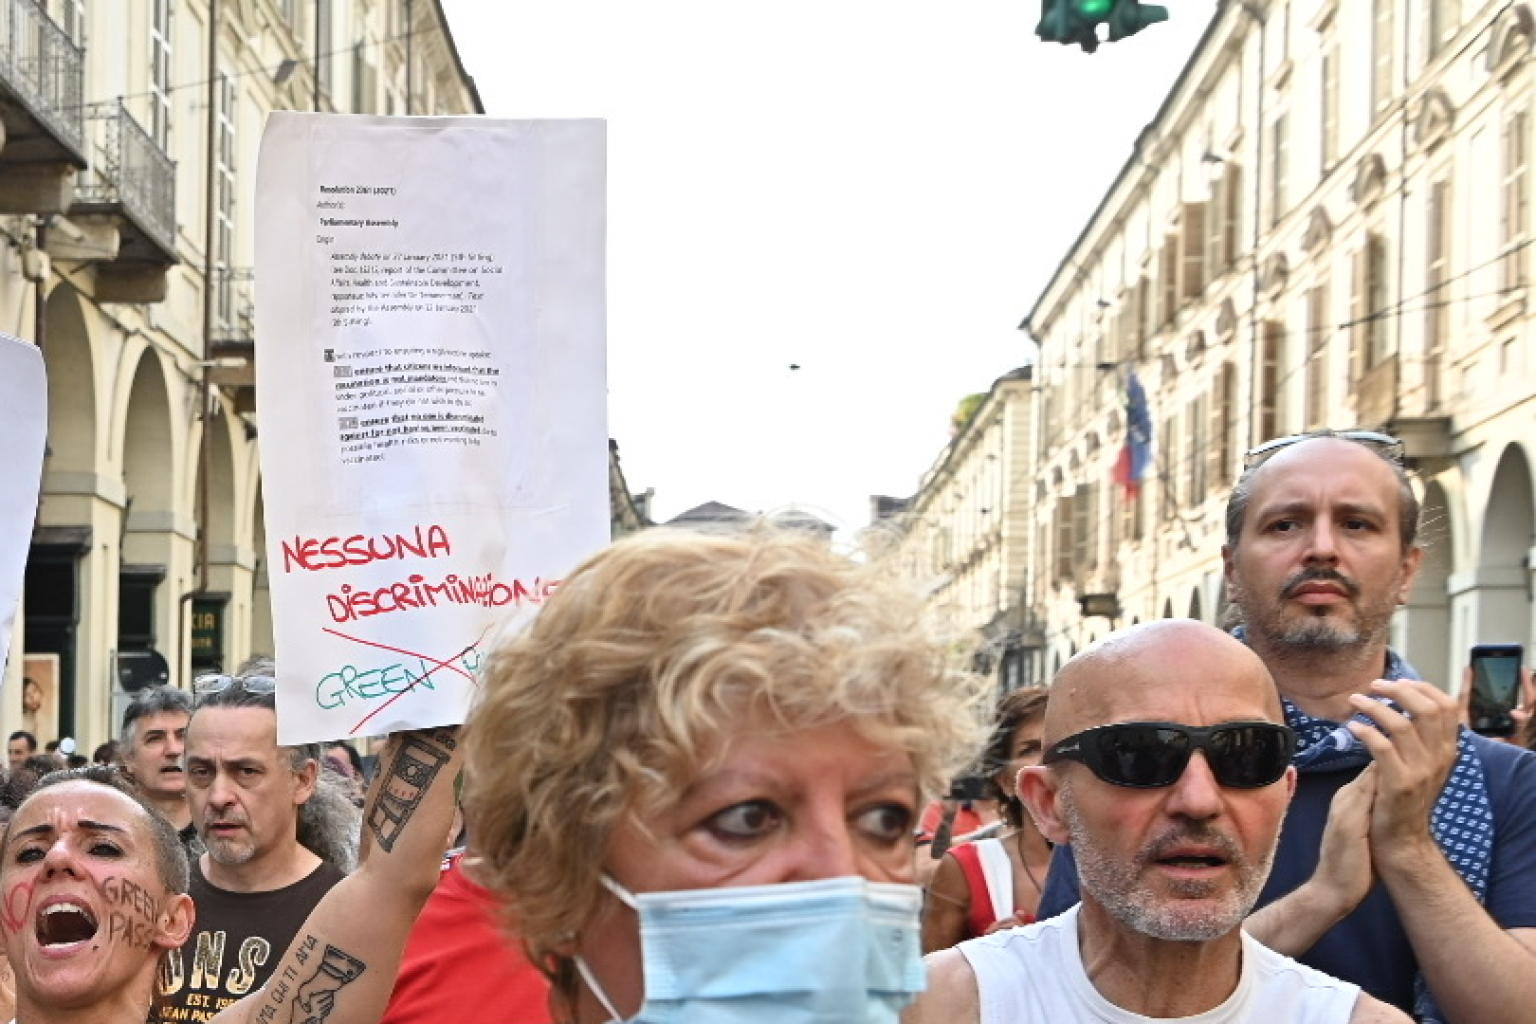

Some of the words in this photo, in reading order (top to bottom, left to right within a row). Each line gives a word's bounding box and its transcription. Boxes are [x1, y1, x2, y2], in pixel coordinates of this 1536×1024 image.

[282, 525, 451, 573] NESSUNA
[316, 660, 435, 709] GREEN
[103, 875, 161, 925] GREEN
